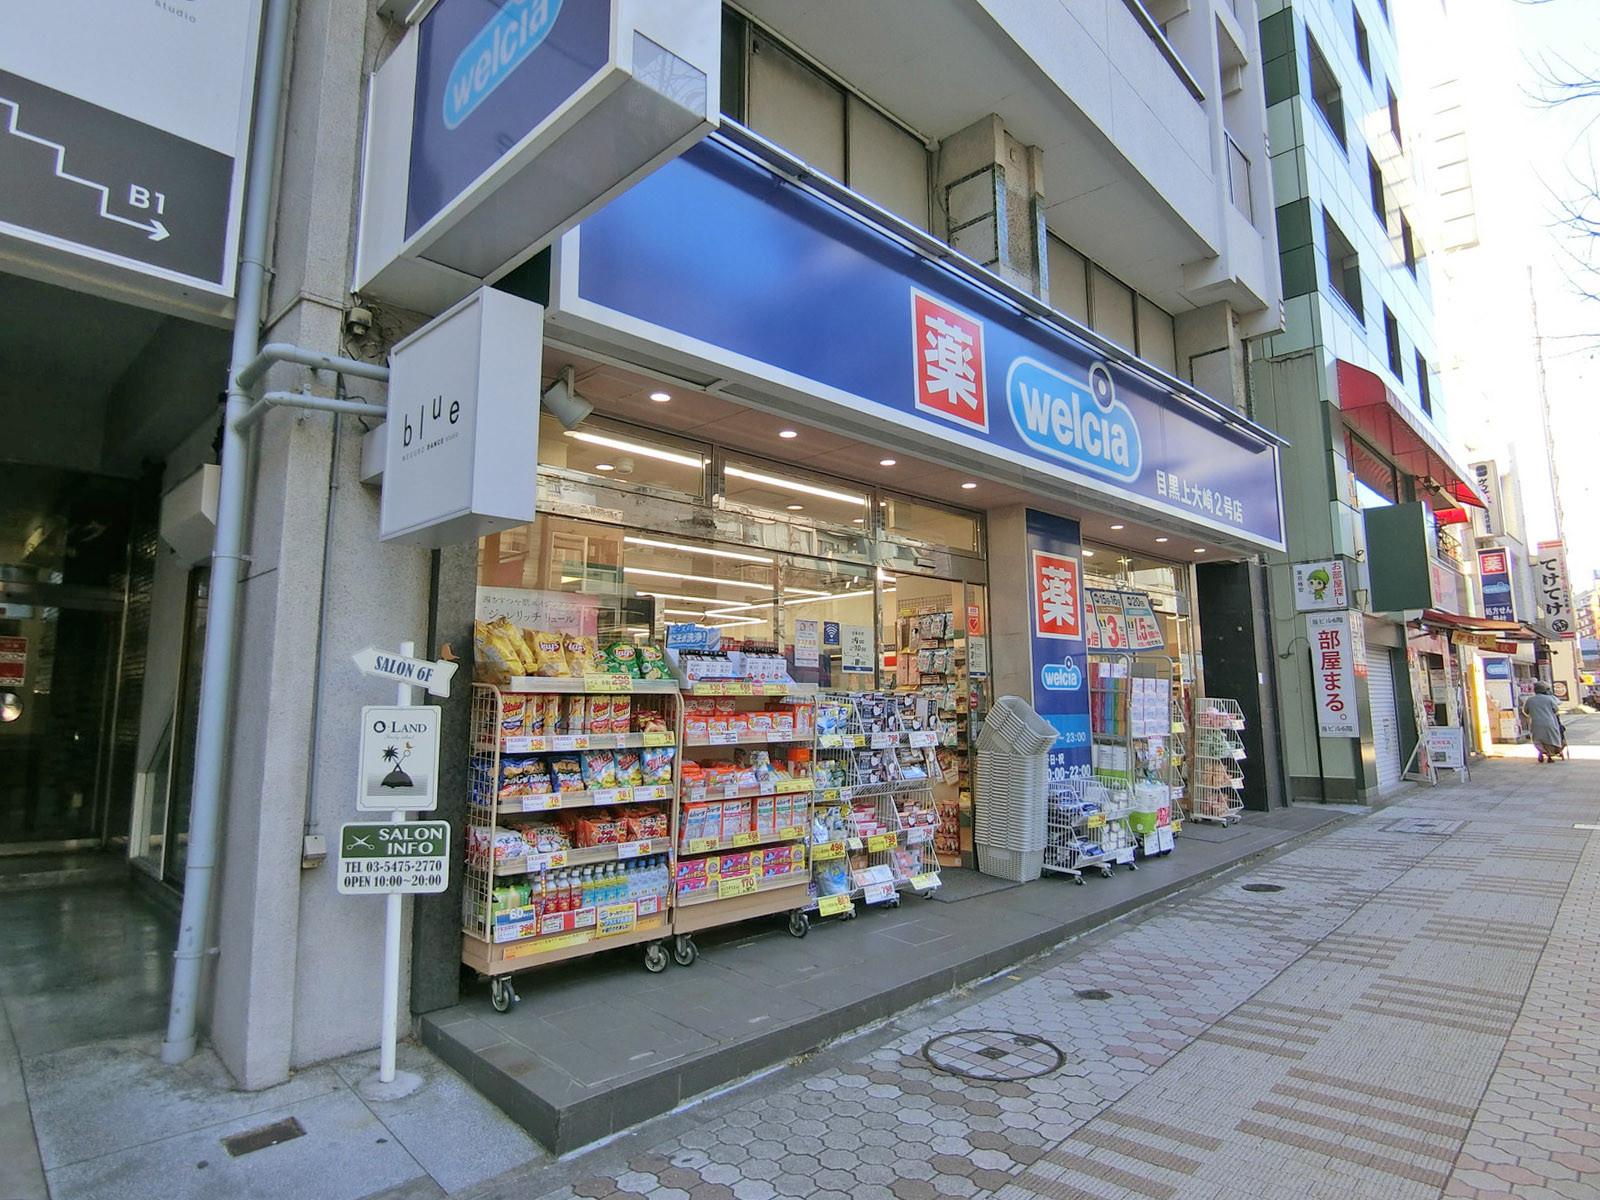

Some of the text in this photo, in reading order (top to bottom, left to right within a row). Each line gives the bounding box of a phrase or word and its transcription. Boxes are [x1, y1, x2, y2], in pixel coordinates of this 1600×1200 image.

[155, 0, 196, 23] studio
[453, 0, 548, 113] welcia
[129, 184, 166, 215] B1
[924, 315, 979, 411] 薬
[403, 394, 460, 448] blue
[1019, 381, 1130, 468] welcia
[1156, 468, 1244, 524] 目黒上大崎2号店
[1485, 556, 1503, 572] 薬
[1041, 565, 1076, 627] 薬
[1540, 558, 1563, 616] てけてけ
[1107, 615, 1120, 648] 3
[374, 655, 434, 682] SALON 6F
[1044, 669, 1078, 687] welcia
[1318, 630, 1348, 721] 部屋まる。
[1065, 731, 1087, 743] 23:00
[378, 827, 443, 841] SALON
[830, 843, 844, 852] 498
[387, 841, 434, 855] INFO
[345, 859, 442, 873] TEL 03-5475-2770
[344, 874, 442, 888] OPEN 10:00~20:00
[742, 878, 754, 888] 170
